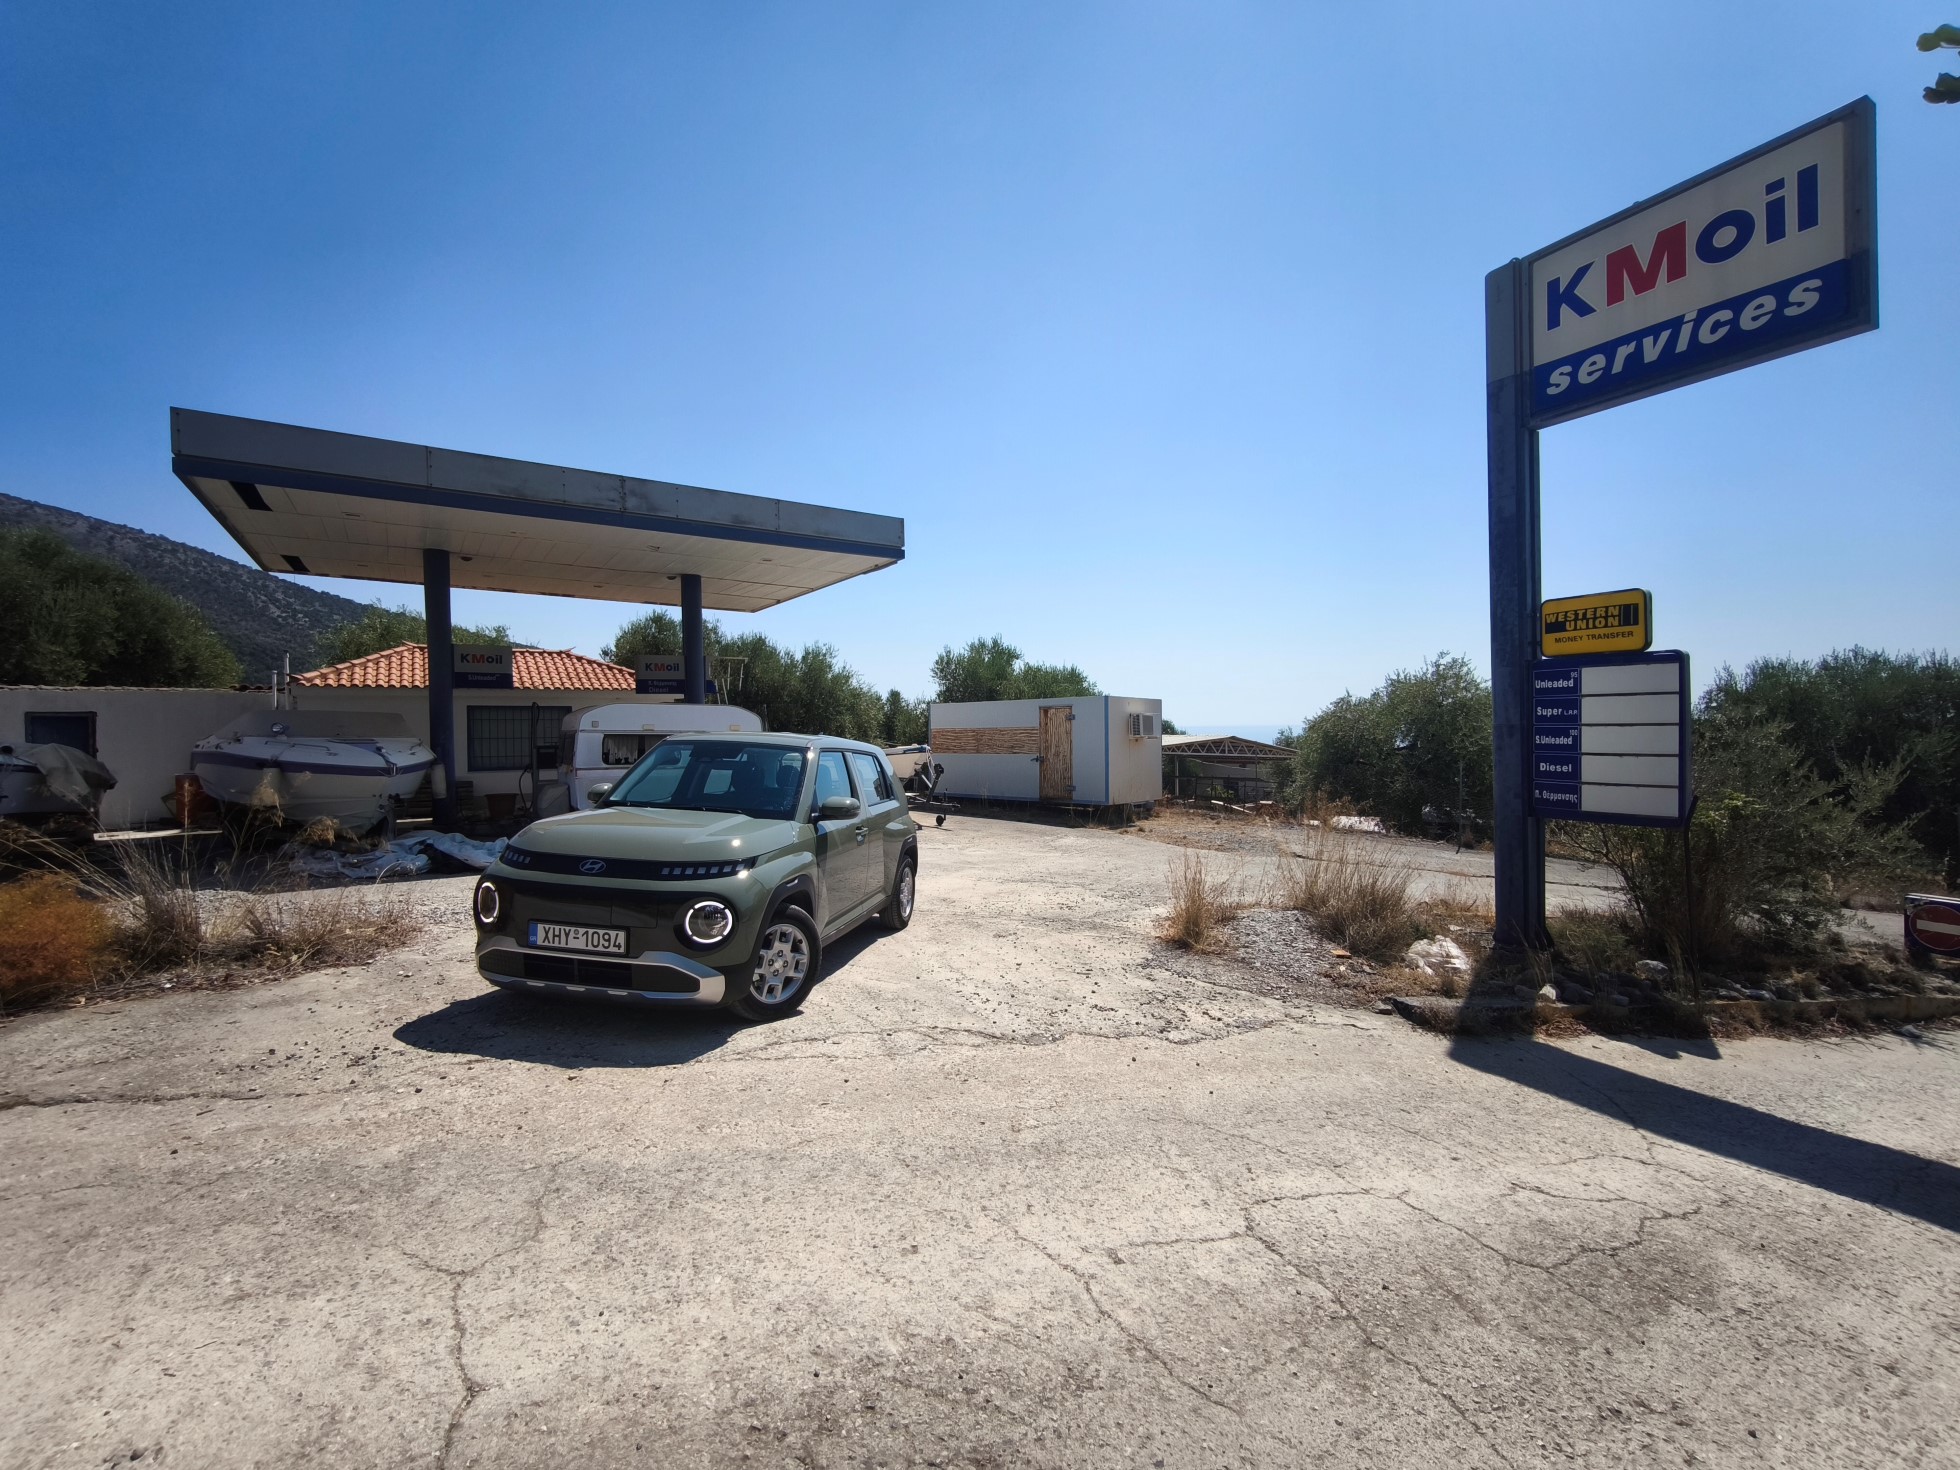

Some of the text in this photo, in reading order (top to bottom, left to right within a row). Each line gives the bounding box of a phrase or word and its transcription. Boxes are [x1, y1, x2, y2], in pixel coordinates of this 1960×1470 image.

[1545, 163, 1819, 332] KMoil
[1546, 278, 1823, 395] services
[1545, 605, 1620, 624] WESTERN
[1565, 616, 1620, 631] UNION
[1554, 630, 1634, 644] MONEY TRANSFER
[460, 653, 503, 665] KMoil
[644, 662, 680, 672] KMoil
[1535, 678, 1574, 689] Unleaded
[1536, 706, 1563, 717] Super
[1535, 735, 1573, 745] S.Unleaded
[1539, 762, 1572, 773] Diesel
